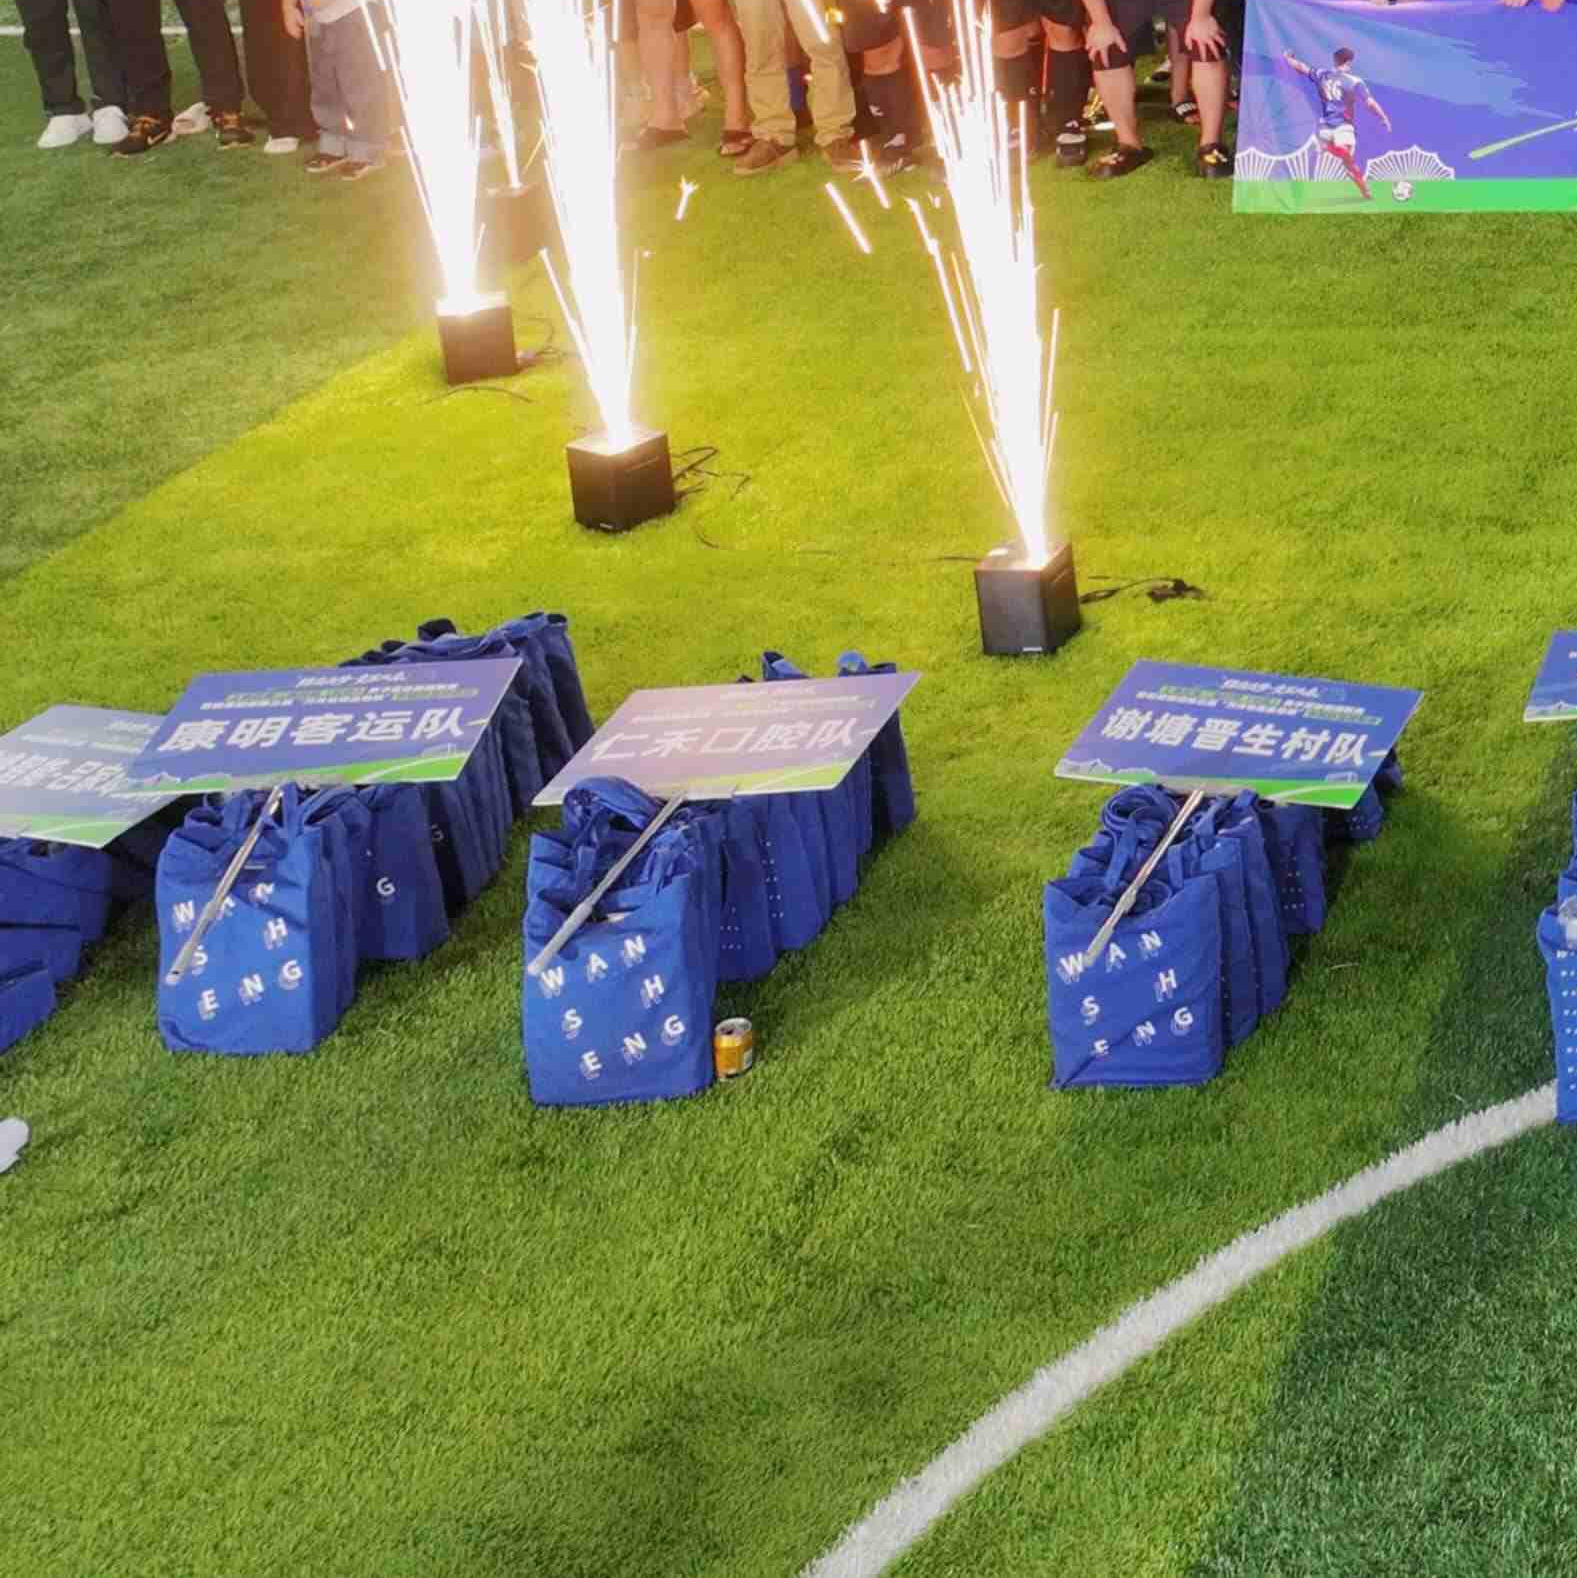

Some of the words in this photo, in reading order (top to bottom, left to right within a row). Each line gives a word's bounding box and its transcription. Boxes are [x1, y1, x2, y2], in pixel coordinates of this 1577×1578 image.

[157, 706, 466, 752] 康明客运队
[591, 717, 859, 762] 仁禾口腔队
[1101, 706, 1373, 768] 谢塘晋生村队
